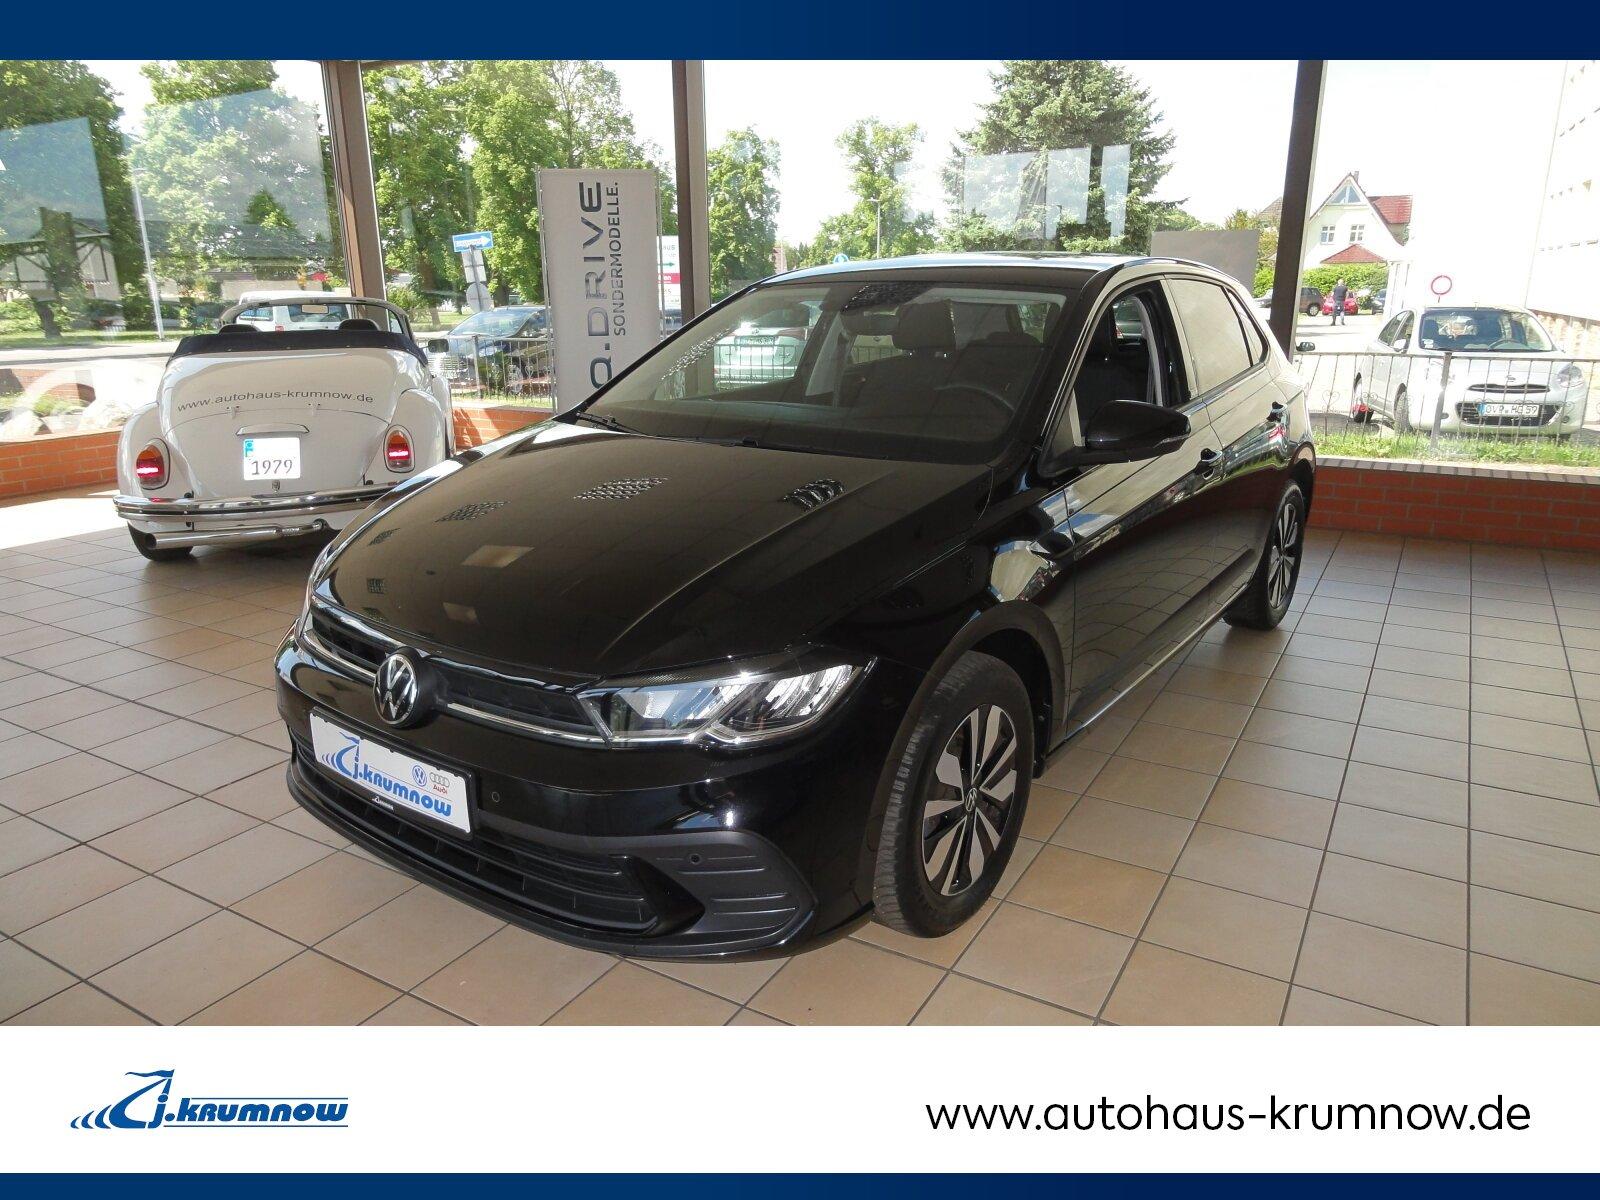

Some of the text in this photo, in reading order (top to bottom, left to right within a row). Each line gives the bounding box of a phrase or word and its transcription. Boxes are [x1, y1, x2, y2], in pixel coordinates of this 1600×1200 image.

[578, 181, 613, 390] Q.DRIVE
[605, 181, 627, 337] SONDERMODELLE.
[177, 389, 375, 412] www.autohaus-krumnow.de
[250, 459, 293, 475] 1979
